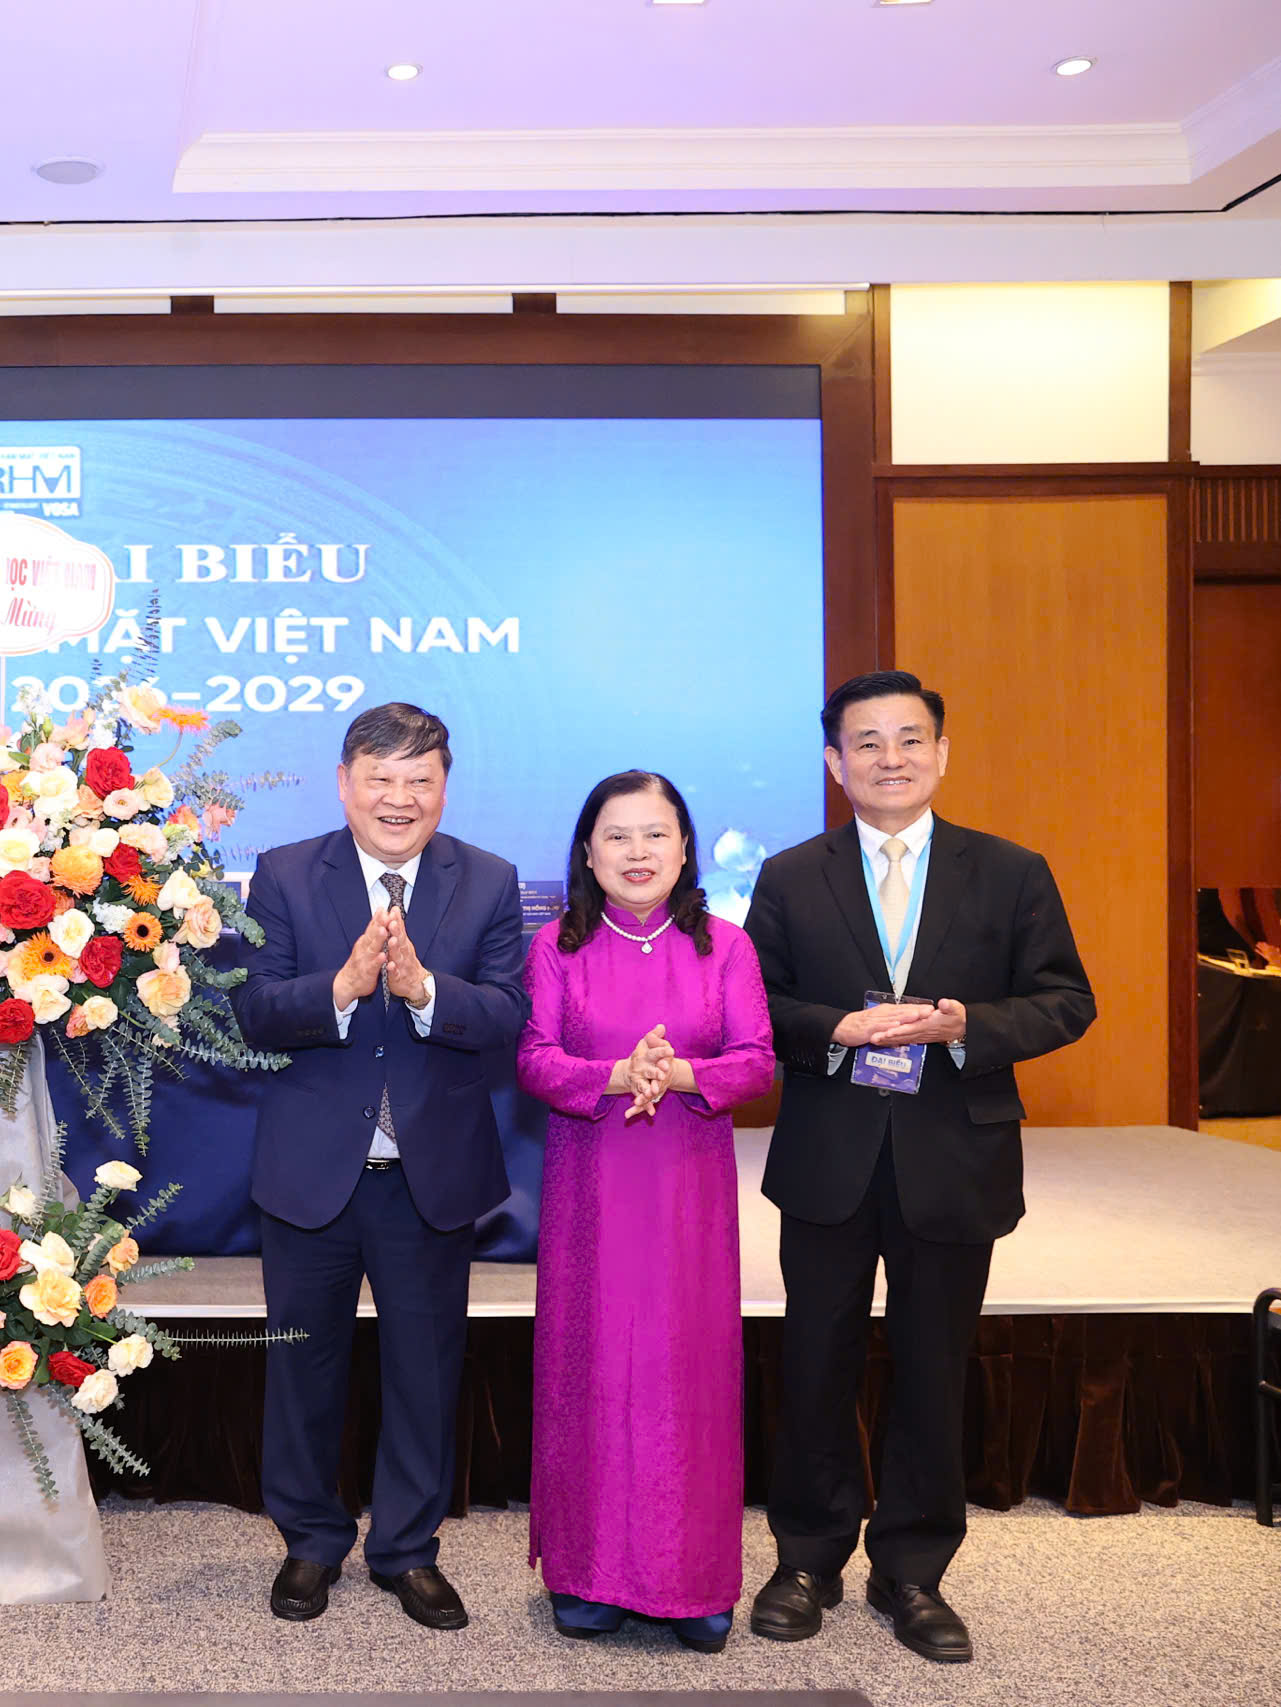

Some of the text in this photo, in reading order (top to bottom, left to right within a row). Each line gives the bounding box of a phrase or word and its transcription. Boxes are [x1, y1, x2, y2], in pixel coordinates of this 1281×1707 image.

[175, 532, 370, 584] BIỂU
[204, 607, 349, 664] VIỆT
[370, 616, 520, 653] NAM
